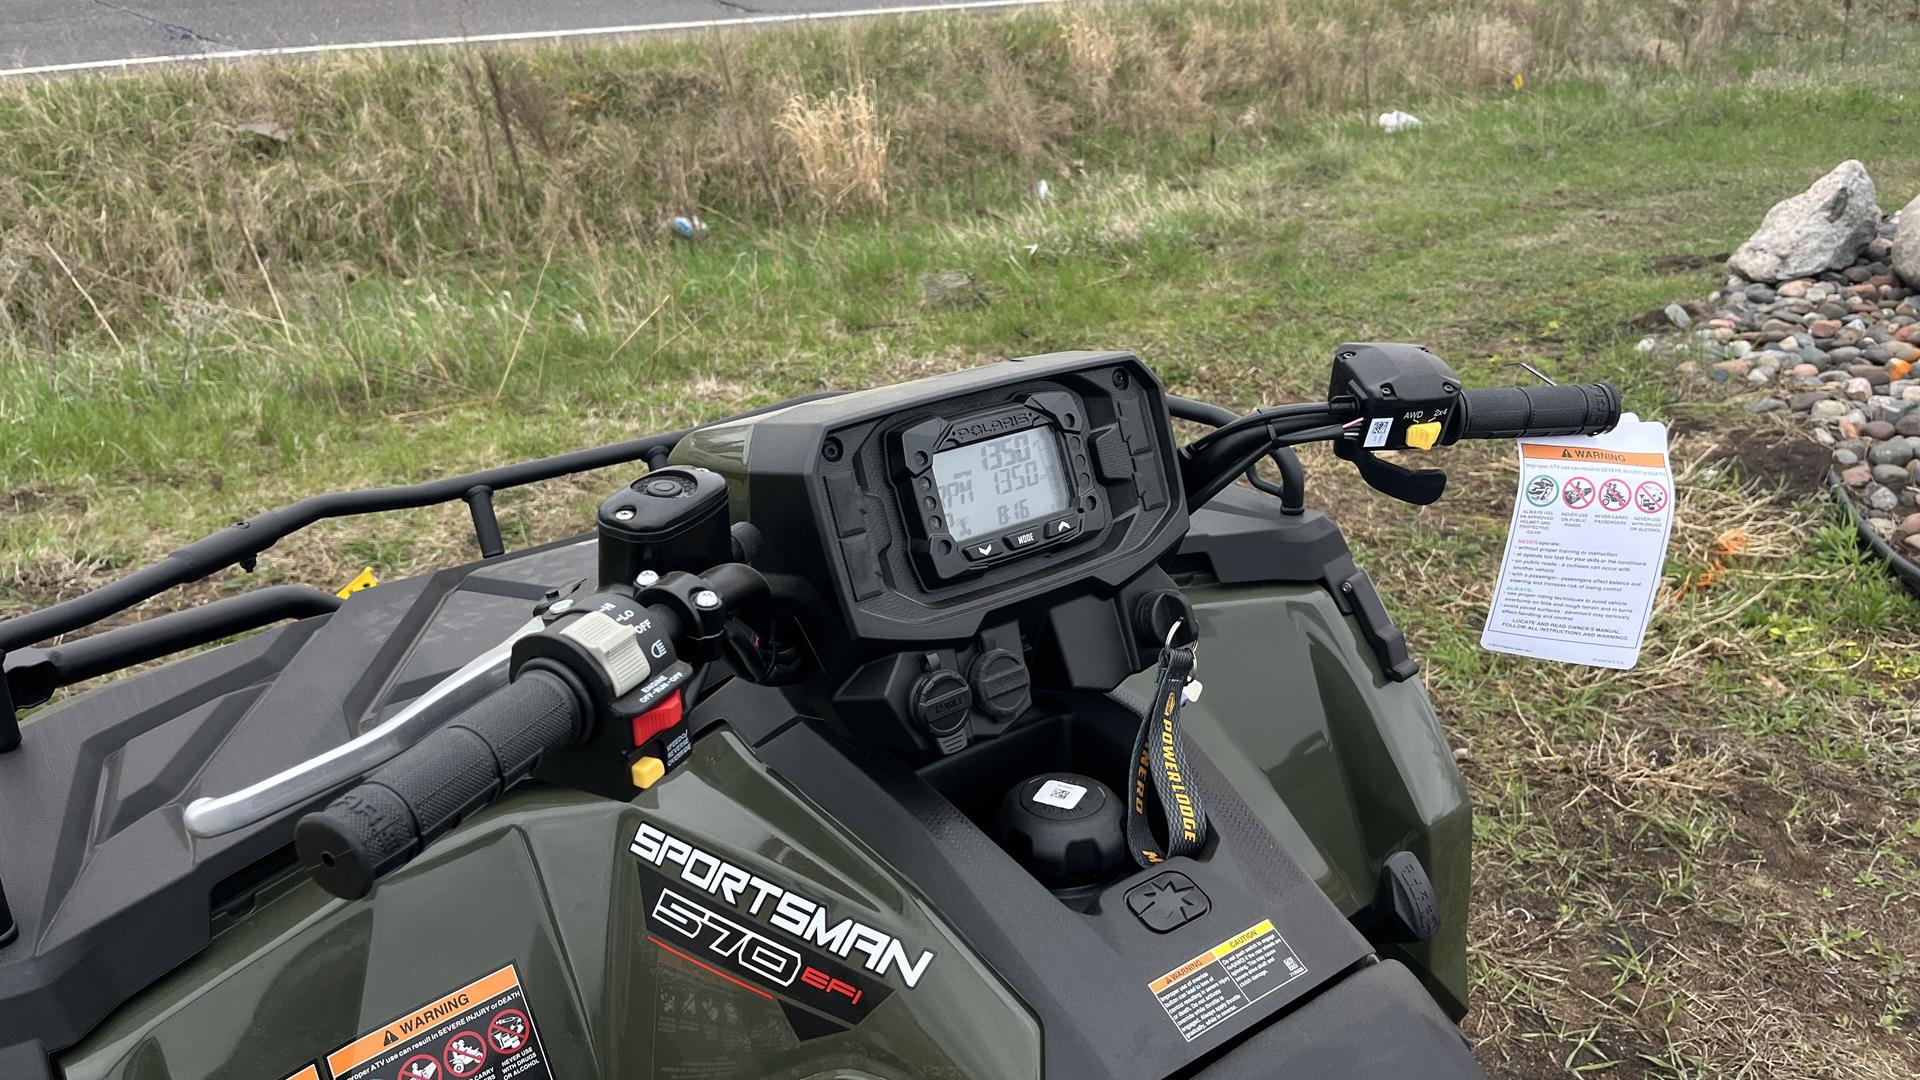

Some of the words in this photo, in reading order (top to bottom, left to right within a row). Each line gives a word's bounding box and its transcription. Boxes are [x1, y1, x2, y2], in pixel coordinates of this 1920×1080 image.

[1403, 411, 1424, 420] AWD
[1434, 408, 1448, 417] 2x4
[958, 413, 1029, 439] POLARIS
[981, 434, 1031, 470] 1350
[1575, 449, 1626, 463] WARNING
[994, 461, 1039, 495] 1350
[1017, 532, 1034, 545] MODE
[635, 619, 651, 634] OFF
[1539, 627, 1581, 636] INSTRUCTIONS
[630, 823, 934, 988] SPORTSMAN
[652, 888, 801, 987] 570
[1229, 929, 1257, 947] CAUTION
[1171, 959, 1202, 980] WARNING
[801, 966, 862, 1005] EFI
[400, 994, 469, 1034] WARNING
[371, 1059, 384, 1072] ATV
[386, 1054, 398, 1064] use
[399, 1047, 411, 1057] can
[412, 1036, 431, 1051] result
[438, 1018, 466, 1036] SEVERE
[466, 1006, 490, 1022] INJURY
[498, 991, 520, 1005] DEATH
[501, 1053, 520, 1066] NEVER
[521, 1047, 533, 1056] USE
[502, 1062, 517, 1074] WITH
[517, 1052, 537, 1065] DRUGS
[475, 1067, 494, 1080] CARRY
[513, 1060, 540, 1075] ALCOHOL
